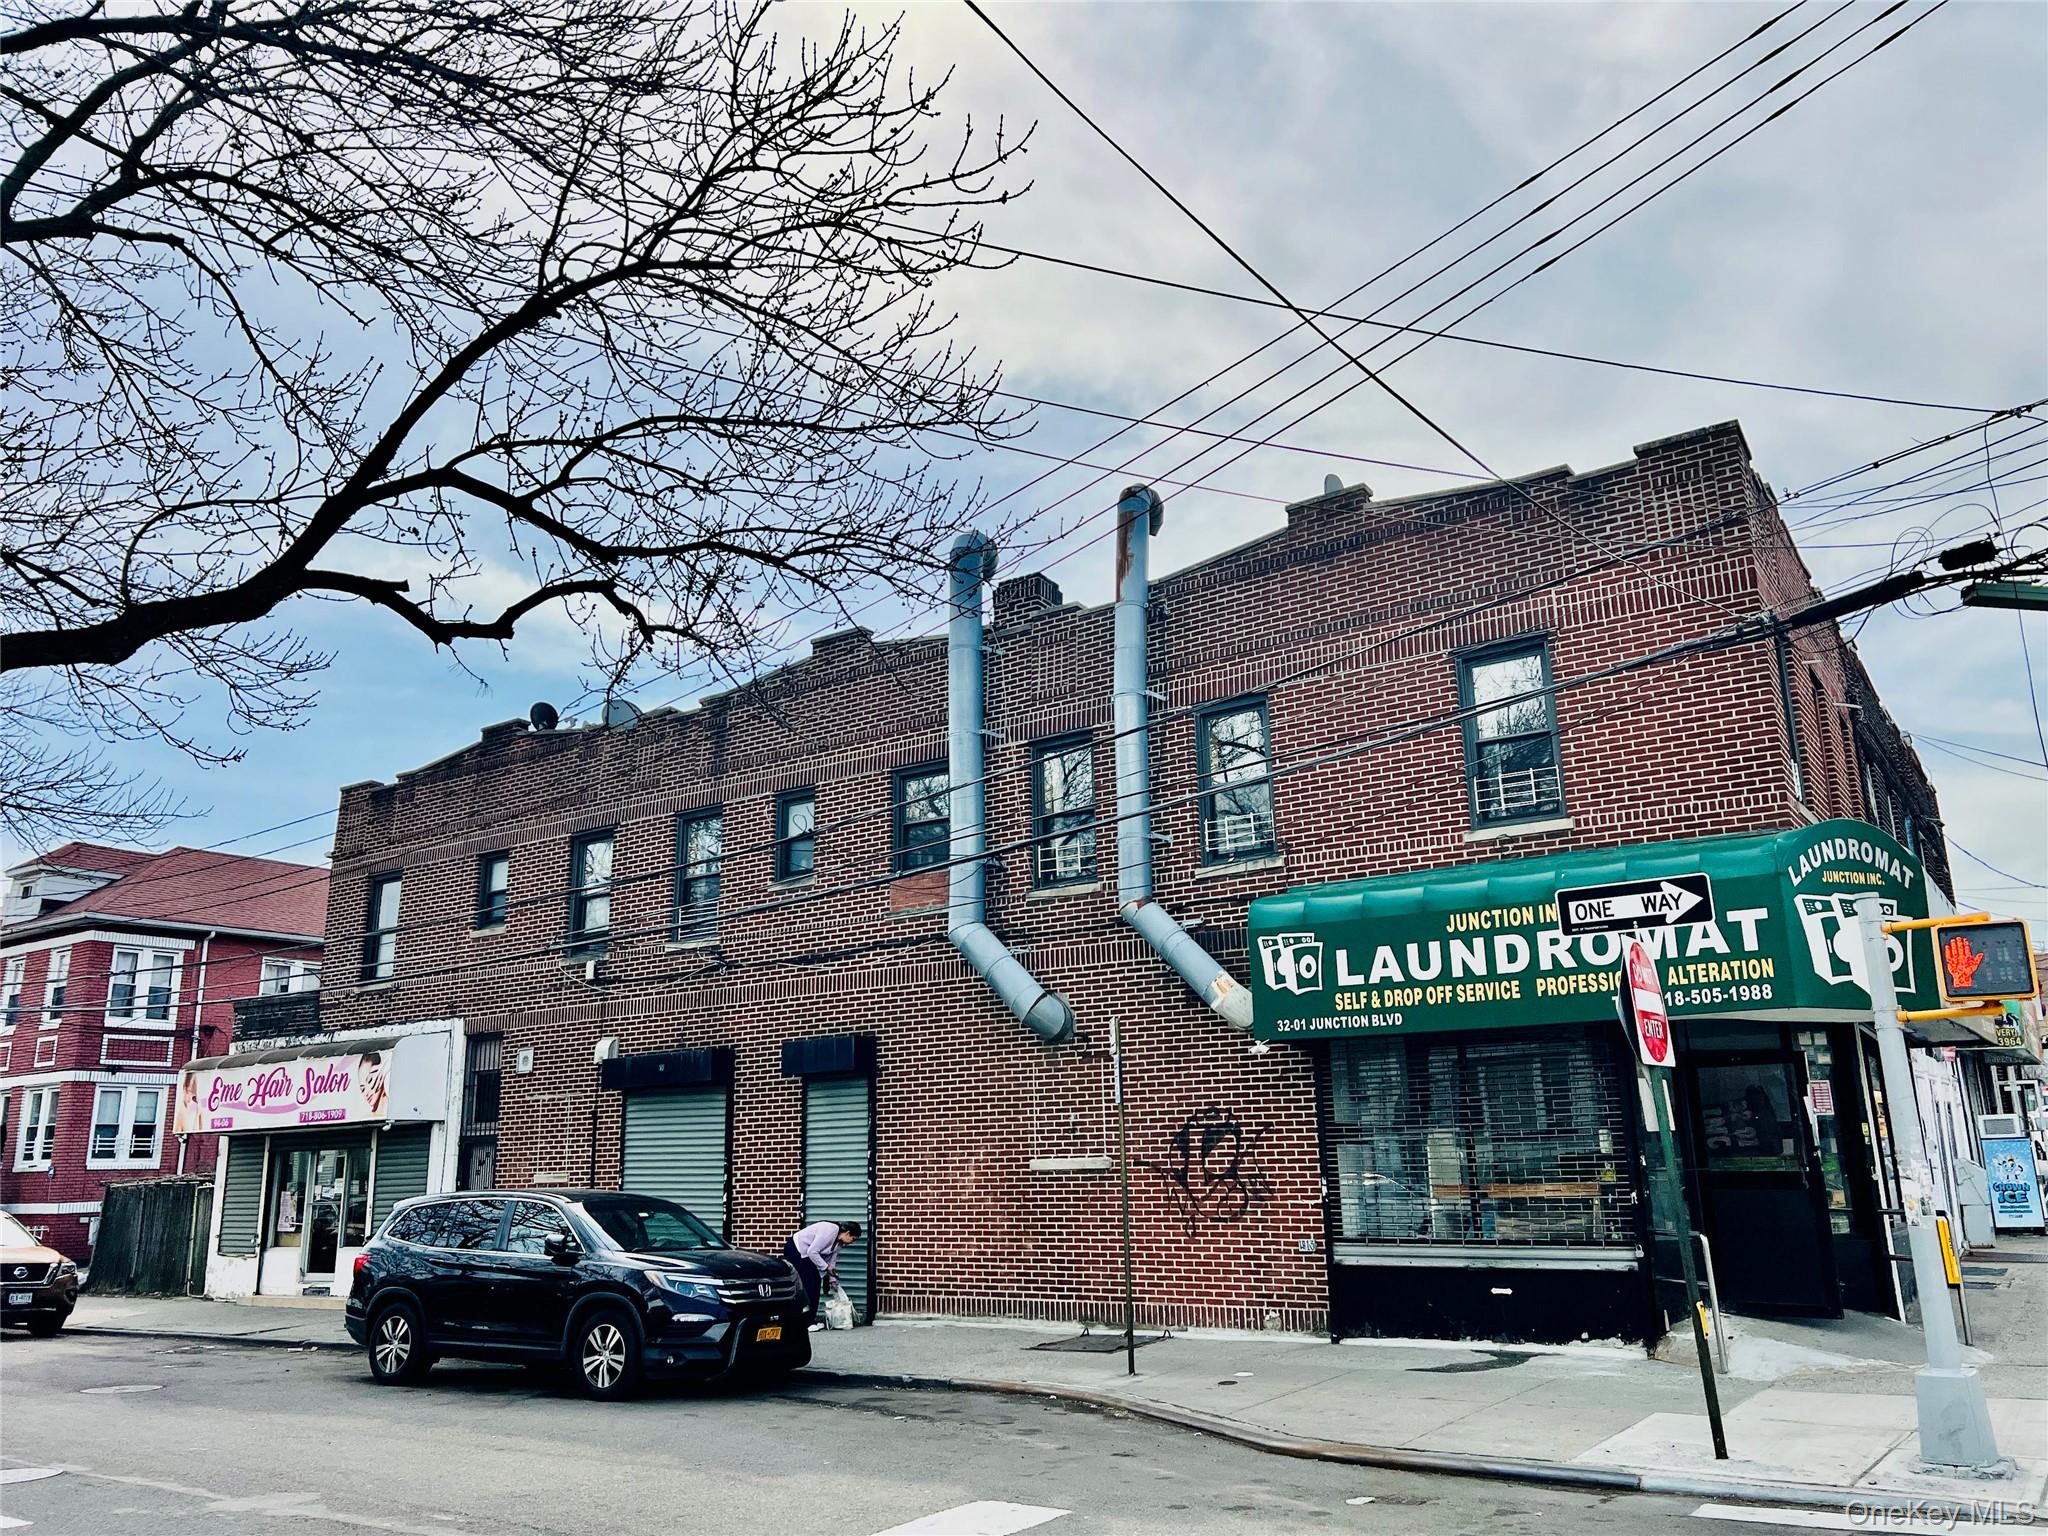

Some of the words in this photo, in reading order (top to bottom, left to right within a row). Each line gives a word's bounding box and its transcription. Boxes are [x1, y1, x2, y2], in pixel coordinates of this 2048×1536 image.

[1788, 838, 1914, 889] LAUNDROMAT
[1822, 870, 1866, 885] JUNCTION
[1867, 874, 1886, 886] INC.
[1446, 905, 1535, 933] JUNCTION
[1538, 903, 1558, 924] IN
[1575, 900, 1615, 921] ONE
[1641, 892, 1683, 914] WAY
[1335, 907, 1769, 987] LAUNDROMAT
[1334, 991, 1368, 1012] SELF
[1371, 990, 1382, 1009] &
[1384, 986, 1422, 1008] DROP
[1426, 984, 1453, 1005] OFF
[1456, 979, 1521, 1003] SERVICE
[1668, 957, 1774, 986] ALTERATION
[1664, 983, 1773, 1007] 18-505-1988
[1277, 1018, 1307, 1032] 32-01
[1309, 1015, 1369, 1031] JUNCTION
[1371, 1012, 1403, 1027] BLVD
[1644, 1018, 1664, 1039] ENTER
[208, 1076, 243, 1112] Eme
[247, 1067, 293, 1107] Hair
[296, 1063, 350, 1105] Salon
[1998, 1191, 2029, 1203] ICE
